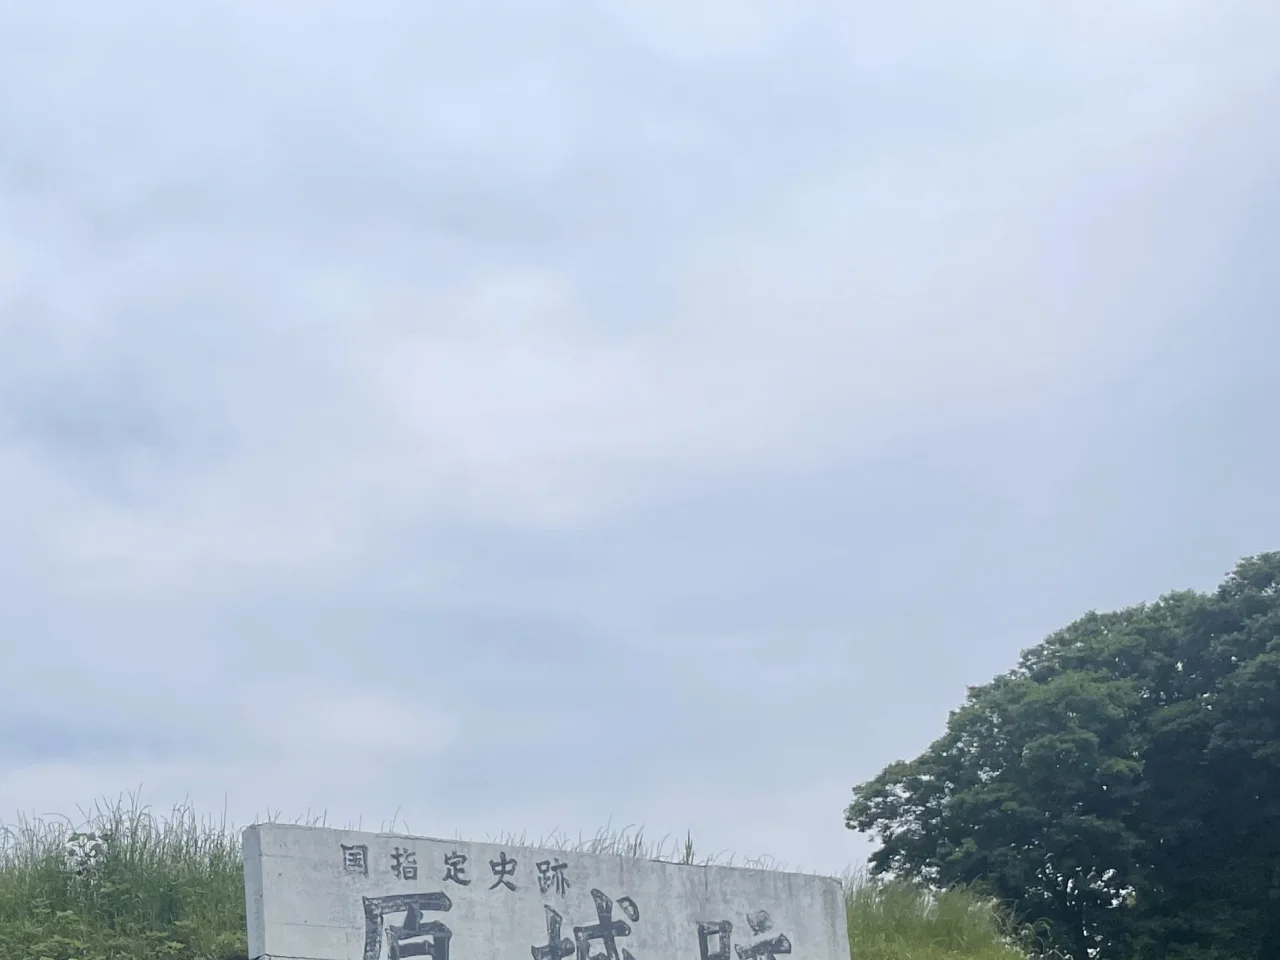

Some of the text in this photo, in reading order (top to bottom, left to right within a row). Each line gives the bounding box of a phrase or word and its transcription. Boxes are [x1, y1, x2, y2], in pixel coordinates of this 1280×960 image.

[340, 844, 570, 898] 国指定史跡
